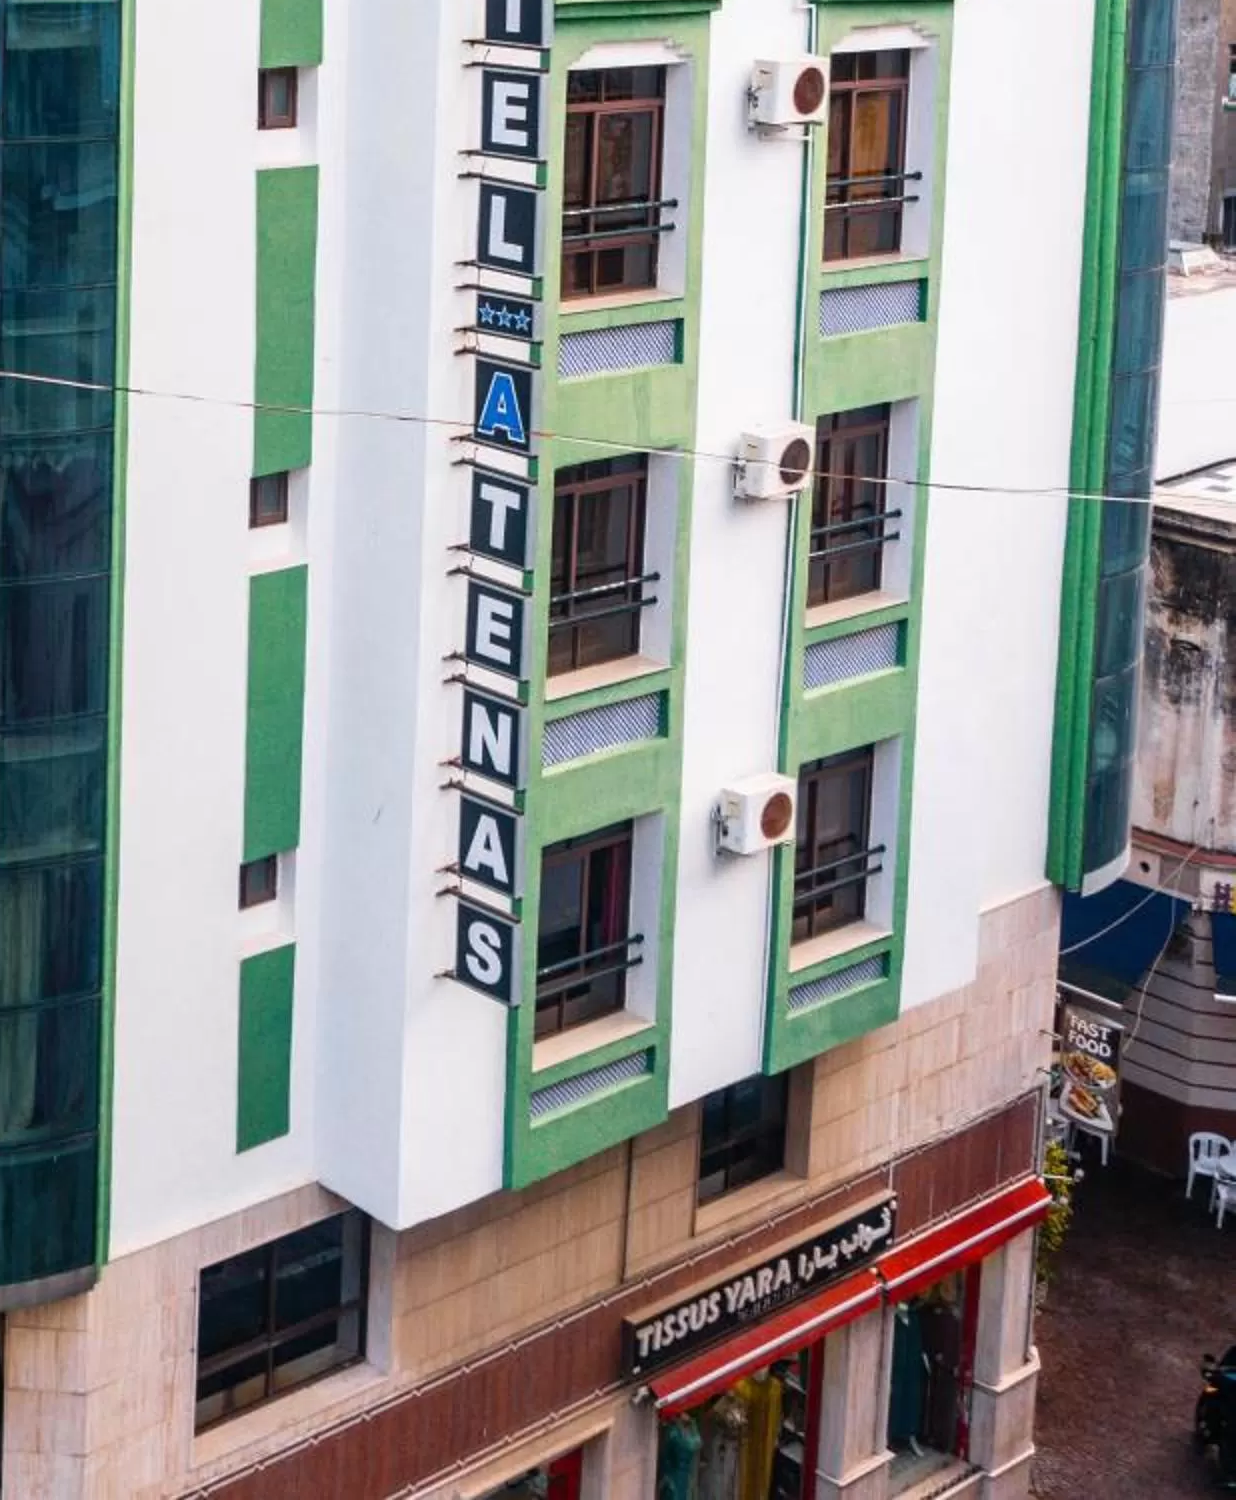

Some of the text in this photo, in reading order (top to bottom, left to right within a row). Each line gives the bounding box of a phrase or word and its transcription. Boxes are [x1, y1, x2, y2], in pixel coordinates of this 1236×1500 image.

[465, 370, 526, 986] ATENAS
[1068, 1029, 1112, 1058] FOOD
[1070, 1015, 1112, 1041] FAST
[635, 1290, 721, 1358] TISSUS
[724, 1257, 792, 1314] YARA
